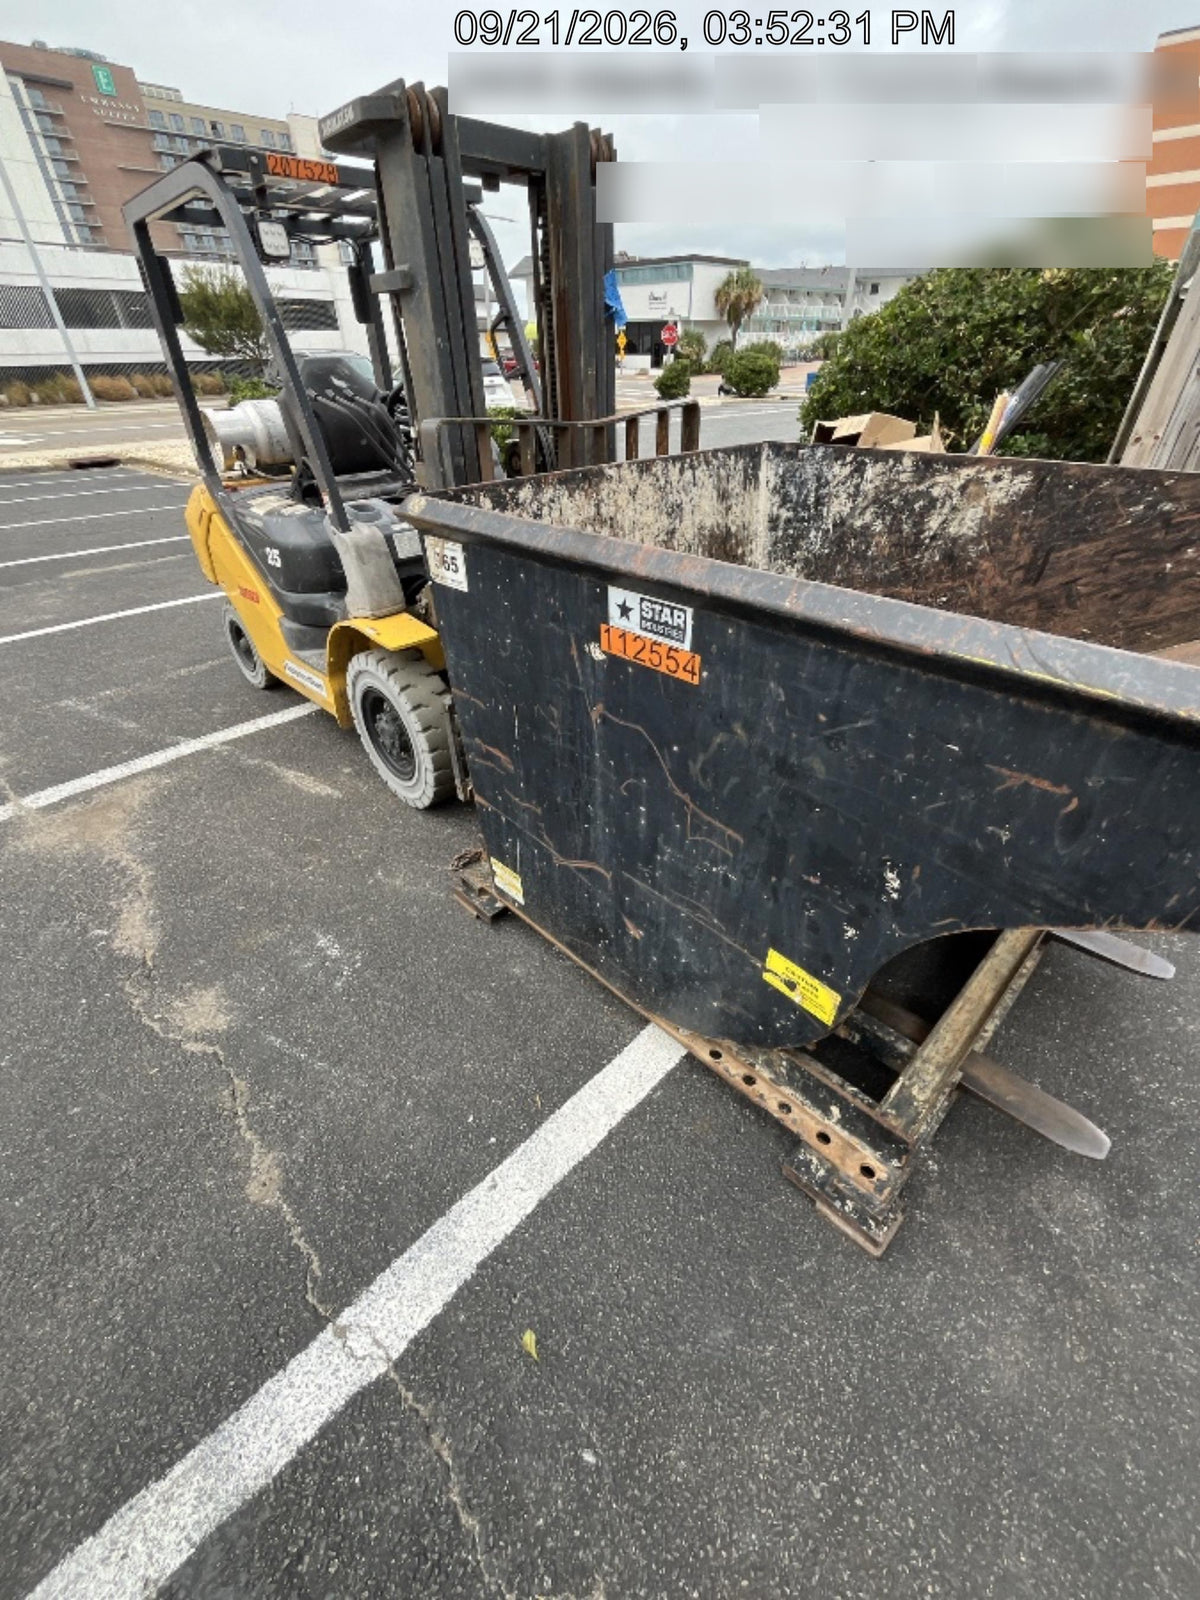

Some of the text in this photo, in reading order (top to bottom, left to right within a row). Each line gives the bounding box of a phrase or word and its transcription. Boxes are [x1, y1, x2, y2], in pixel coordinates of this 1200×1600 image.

[266, 547, 282, 568] 25
[641, 600, 686, 628] STAR
[604, 627, 698, 681] 112554
